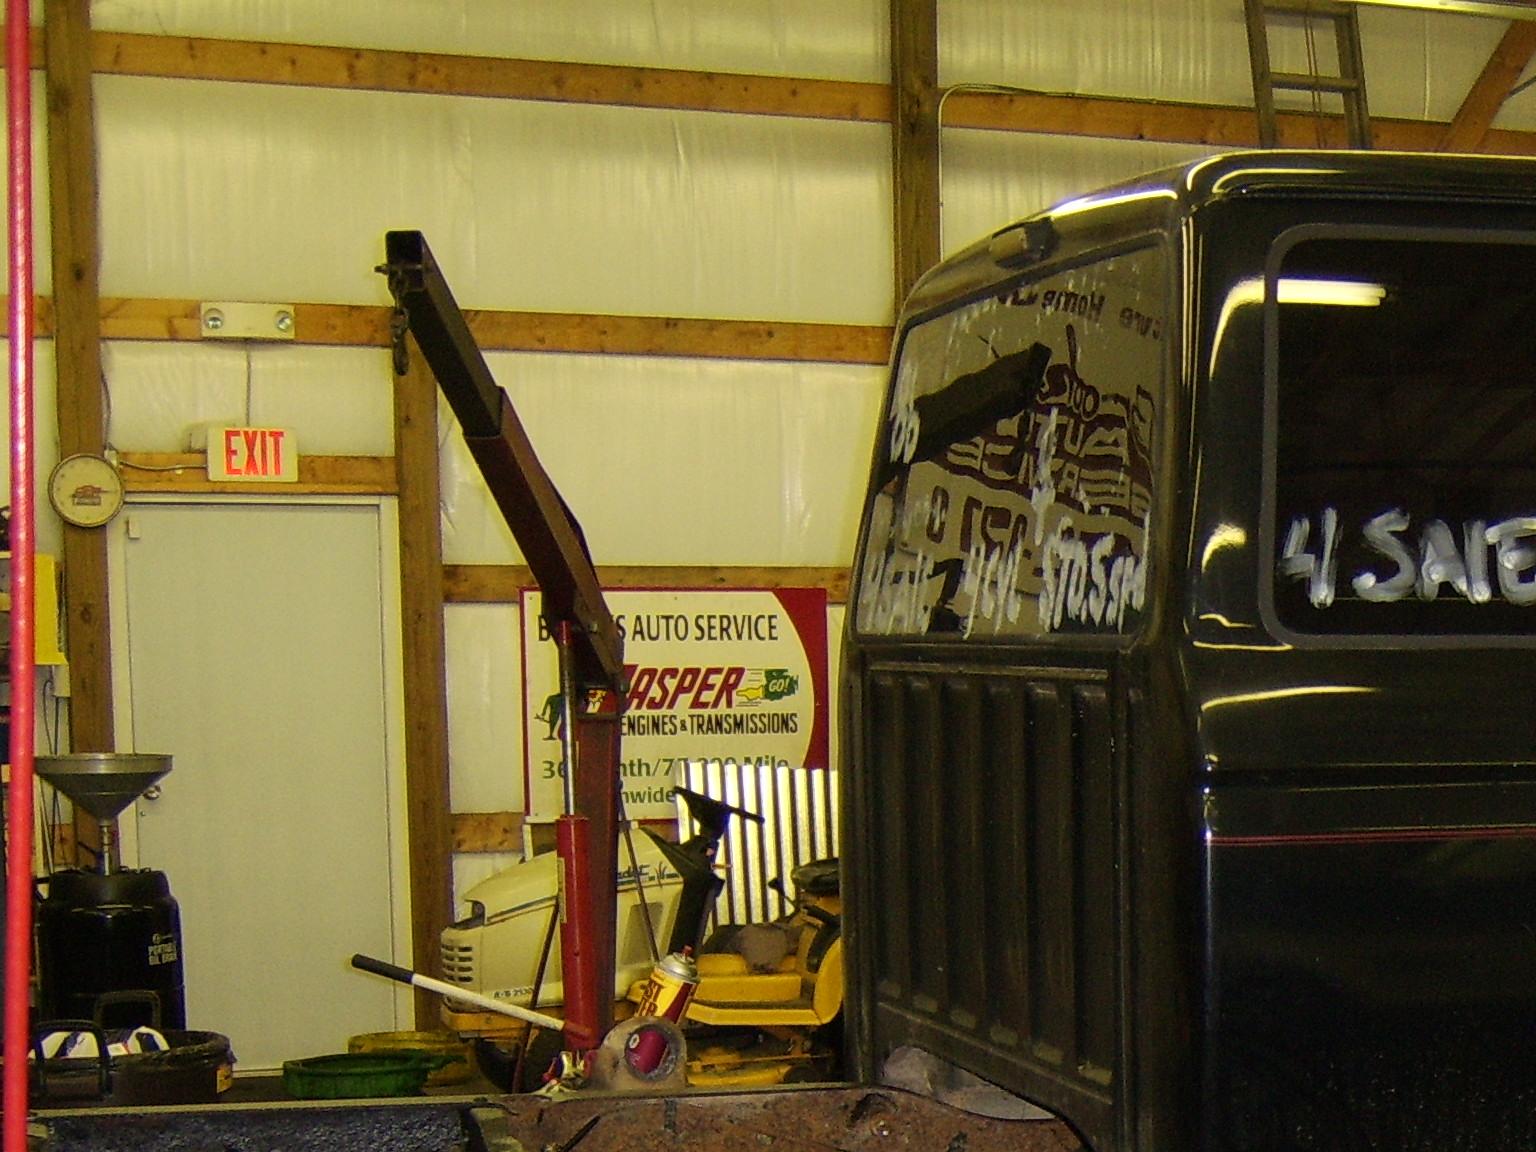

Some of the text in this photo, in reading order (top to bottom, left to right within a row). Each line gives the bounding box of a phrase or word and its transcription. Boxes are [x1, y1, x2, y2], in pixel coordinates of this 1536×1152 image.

[224, 429, 284, 476] EXIT
[1278, 506, 1340, 609] 4
[631, 614, 689, 642] AUTO
[693, 613, 779, 642] SERVICE
[768, 678, 790, 694] GO!
[620, 712, 799, 737] ENGINES & TRANSMISSIONS
